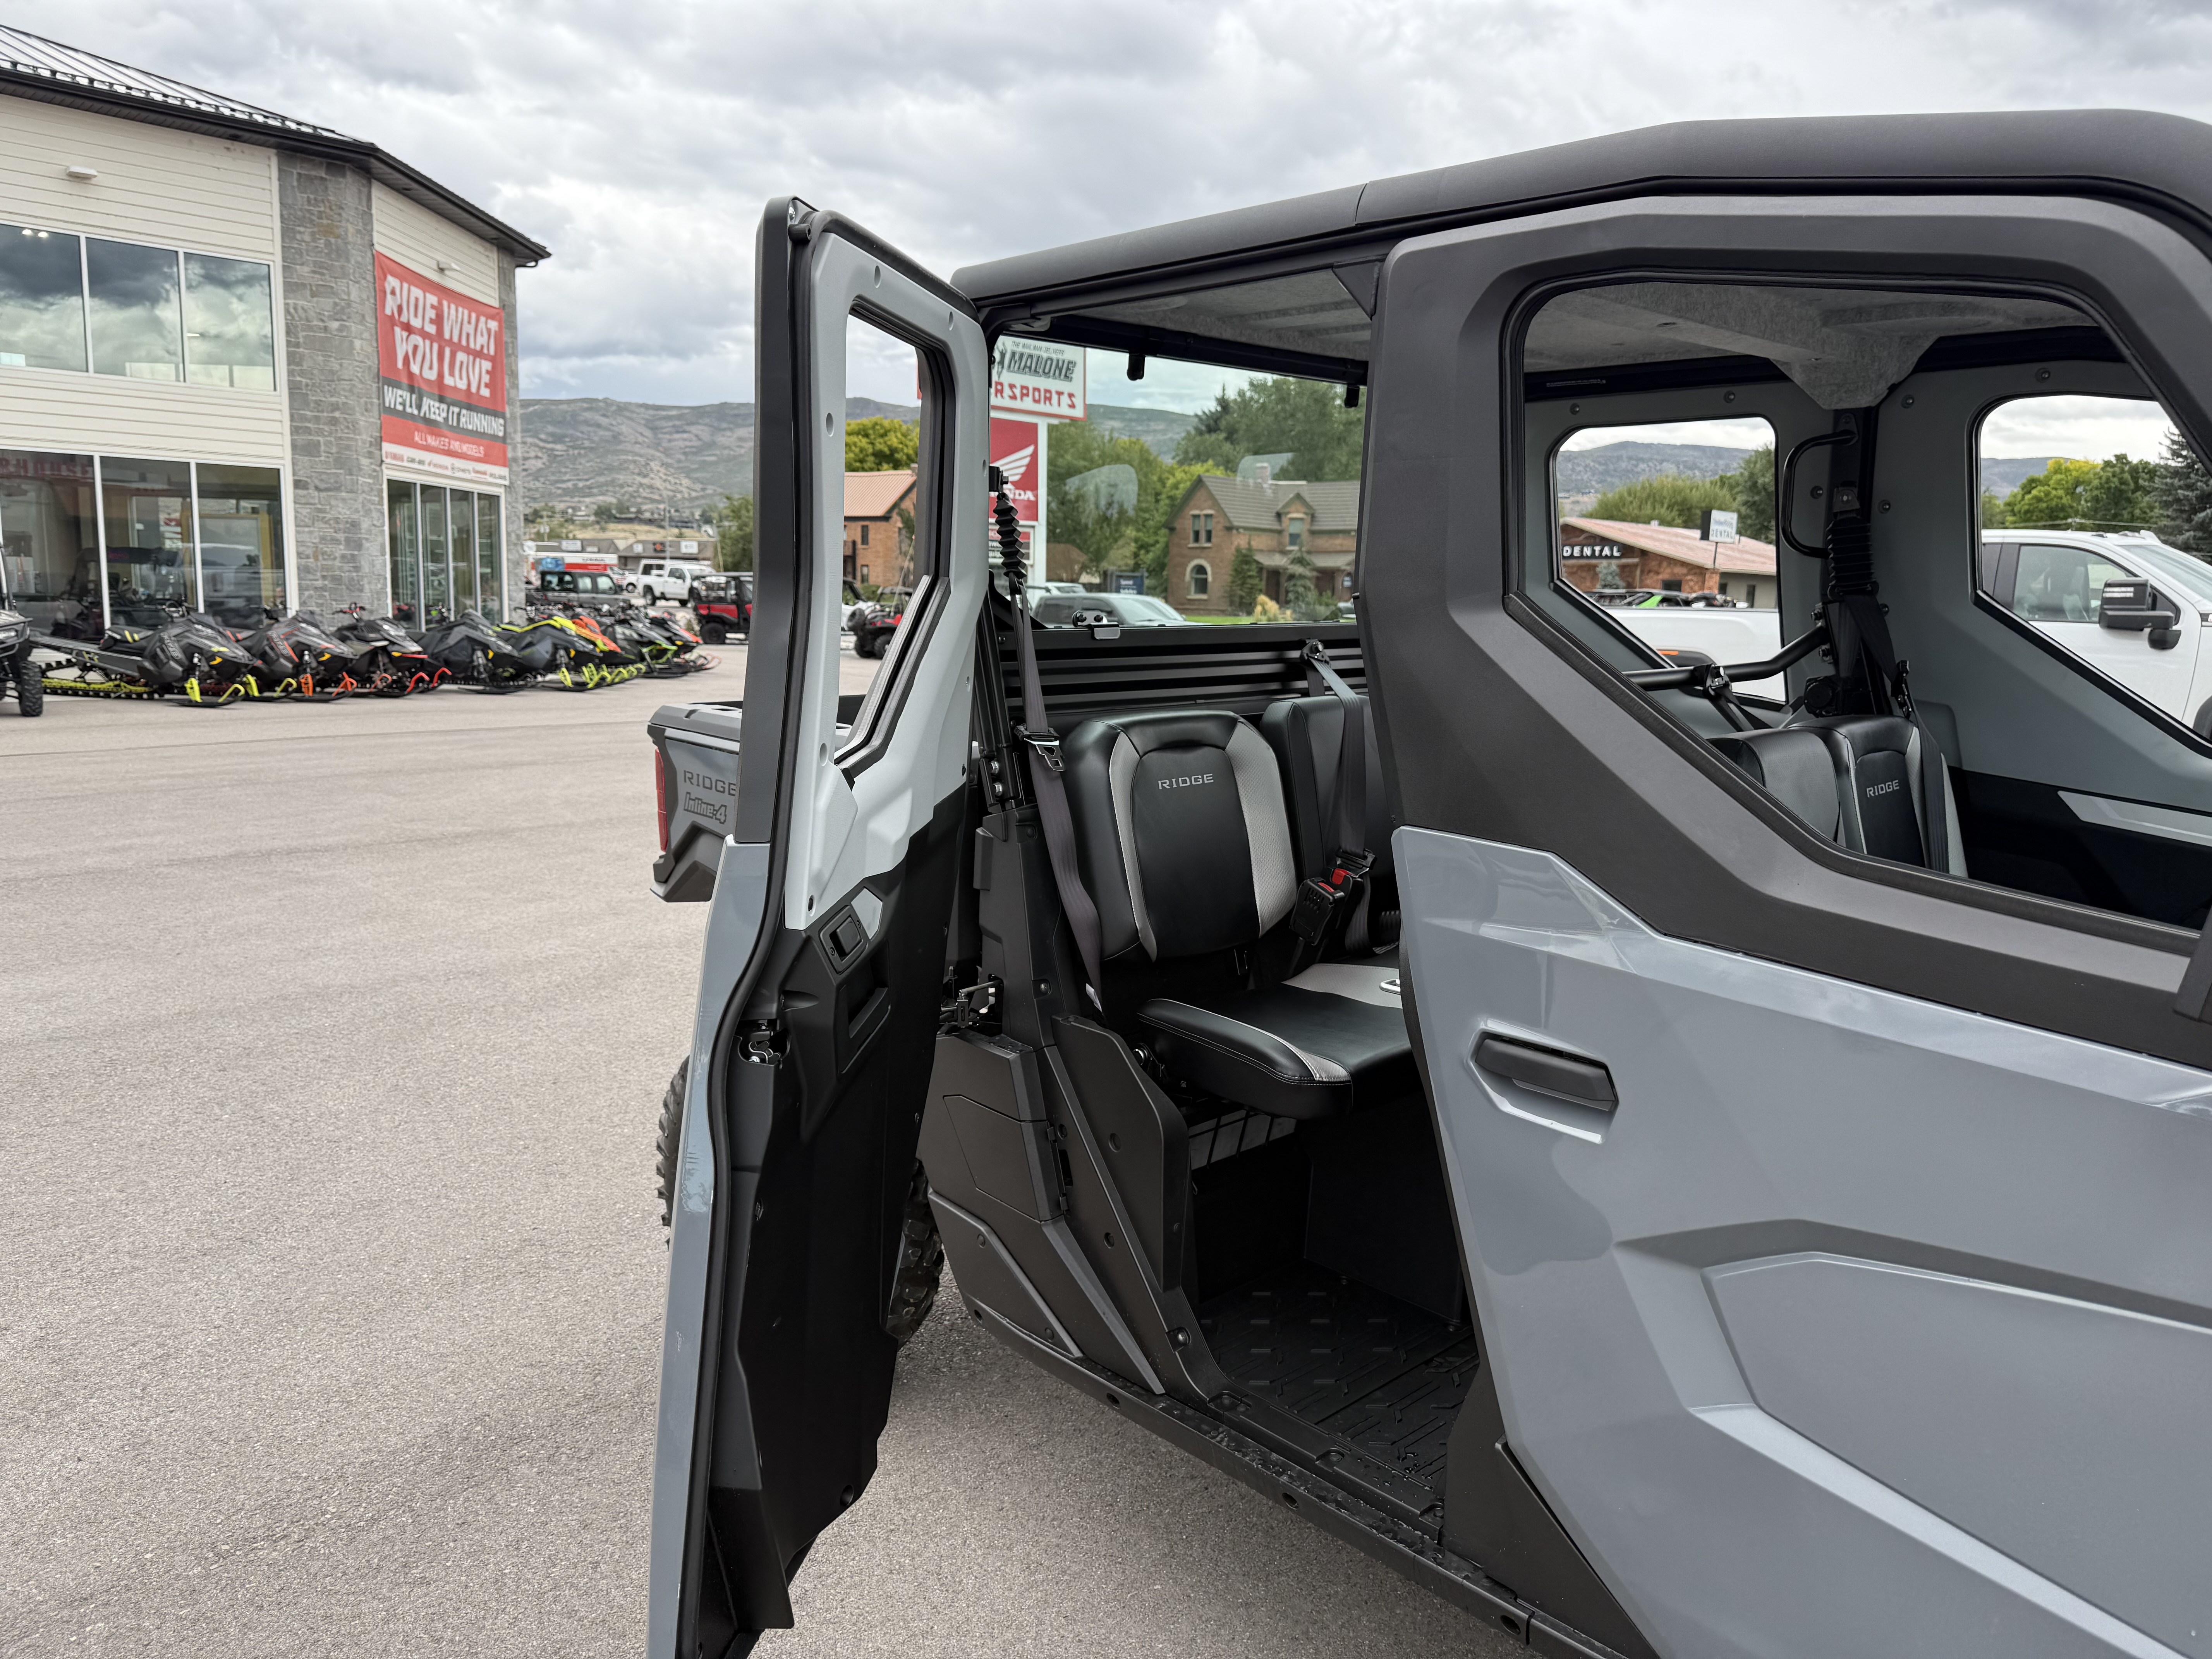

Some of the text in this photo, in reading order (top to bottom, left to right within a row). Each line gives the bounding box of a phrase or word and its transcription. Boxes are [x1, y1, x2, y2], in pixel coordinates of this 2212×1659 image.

[385, 274, 498, 355] RIDE WHAT
[394, 326, 492, 398] YOU LOVE
[1007, 349, 1076, 383] MALONE
[994, 381, 1076, 409] RSPORTS
[384, 385, 505, 437] WE'LL KEEP IT RUNNING
[414, 431, 426, 445] ALL
[989, 489, 1035, 501] NDA
[1563, 546, 1621, 556] DENTAL
[684, 770, 736, 796] RIDGE
[1158, 774, 1214, 790] RIDGE
[1867, 780, 1899, 798] RIDGE
[684, 791, 727, 824] Inline-4
